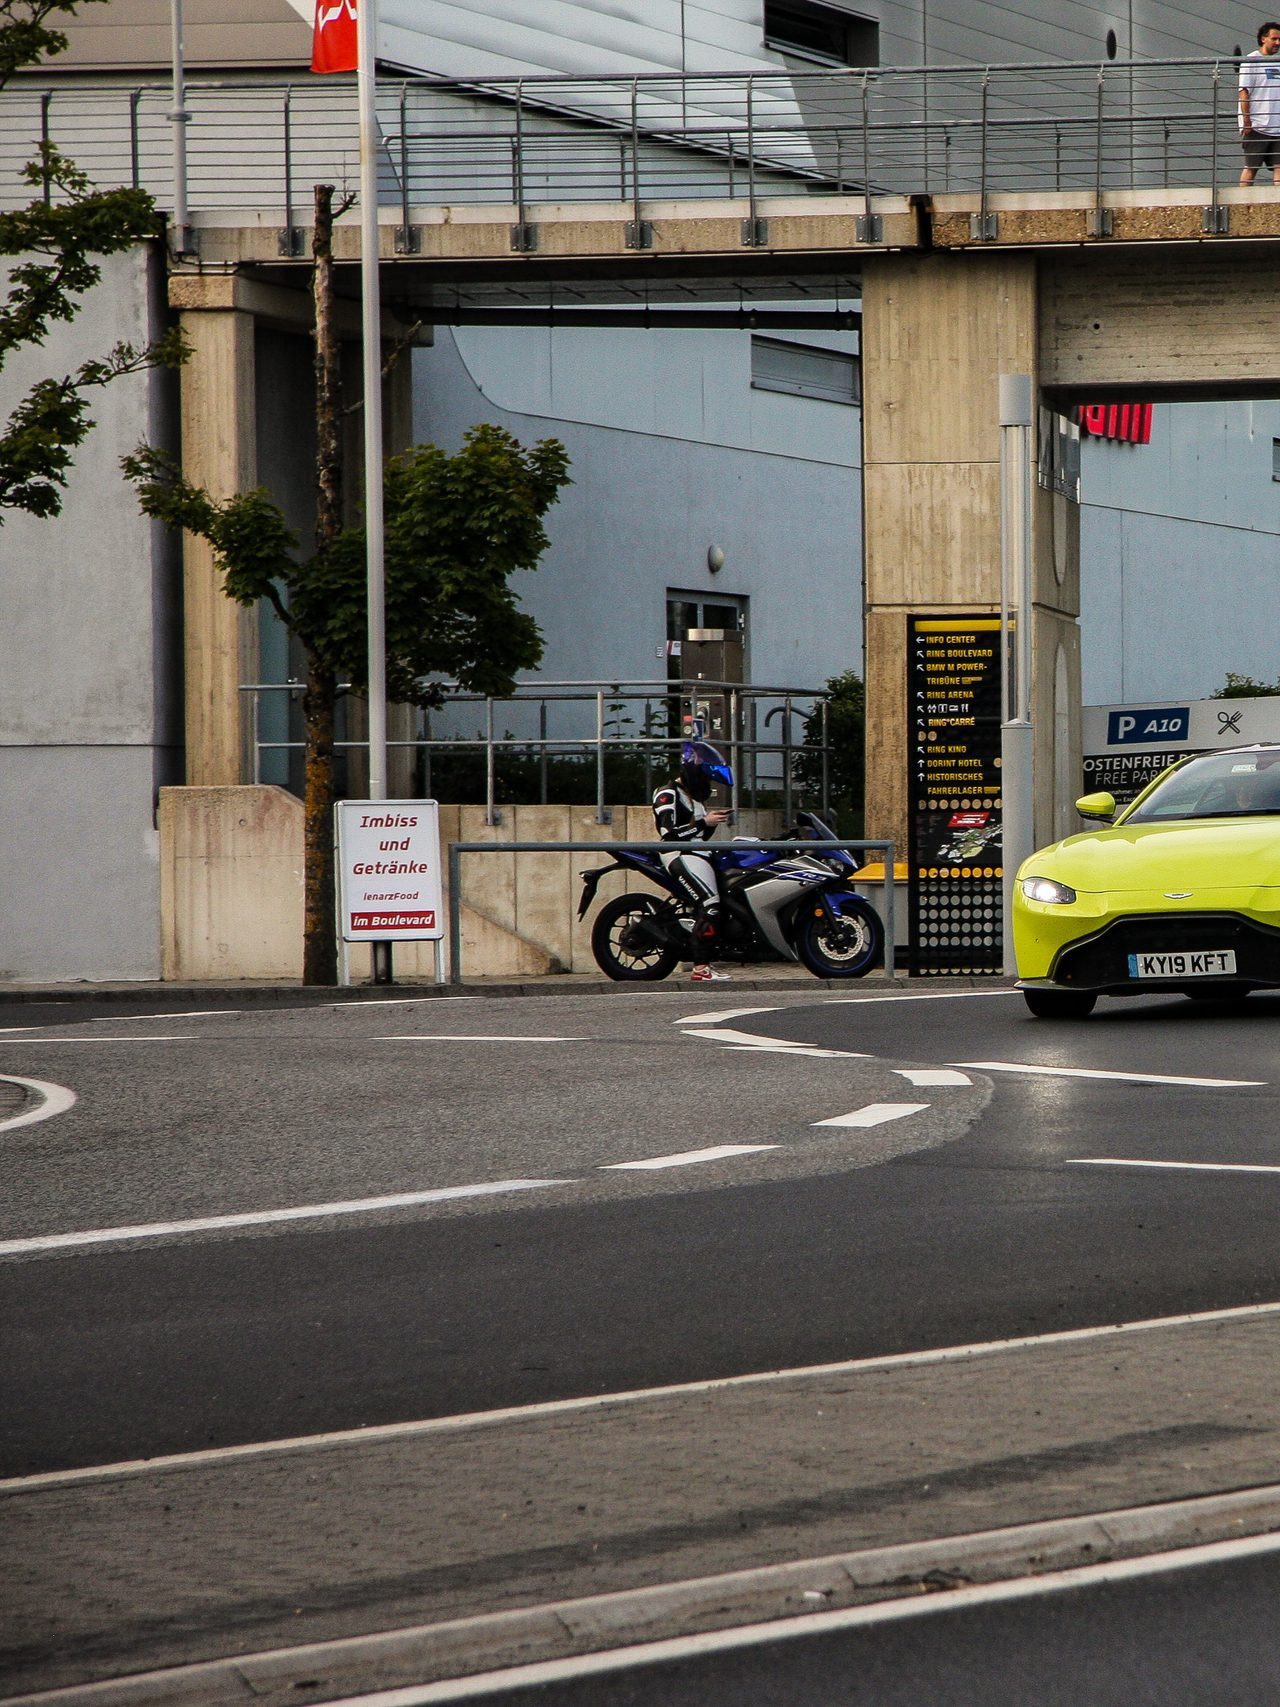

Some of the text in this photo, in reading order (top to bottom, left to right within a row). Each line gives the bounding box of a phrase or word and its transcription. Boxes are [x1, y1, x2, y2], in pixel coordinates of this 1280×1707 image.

[926, 635, 976, 644] INFO CENTER
[947, 649, 993, 657] BOULEVARD
[957, 663, 988, 671] POWER-
[927, 676, 960, 685] TRIBÜNE
[927, 691, 946, 699] RING
[1117, 716, 1182, 740] P A10
[958, 759, 983, 767] HOTEL
[1083, 754, 1175, 772] OSTENFREIE
[927, 773, 984, 781] HISTORISCHES
[1095, 771, 1128, 785] FREE
[927, 787, 983, 795] FAHRERLAGER
[360, 813, 418, 828] Imbiss
[379, 837, 411, 851] und
[353, 860, 428, 875] Getränke
[363, 891, 420, 901] lenarzFood
[353, 914, 433, 926] im Boulevard
[1143, 953, 1228, 975] KY19 KFT
